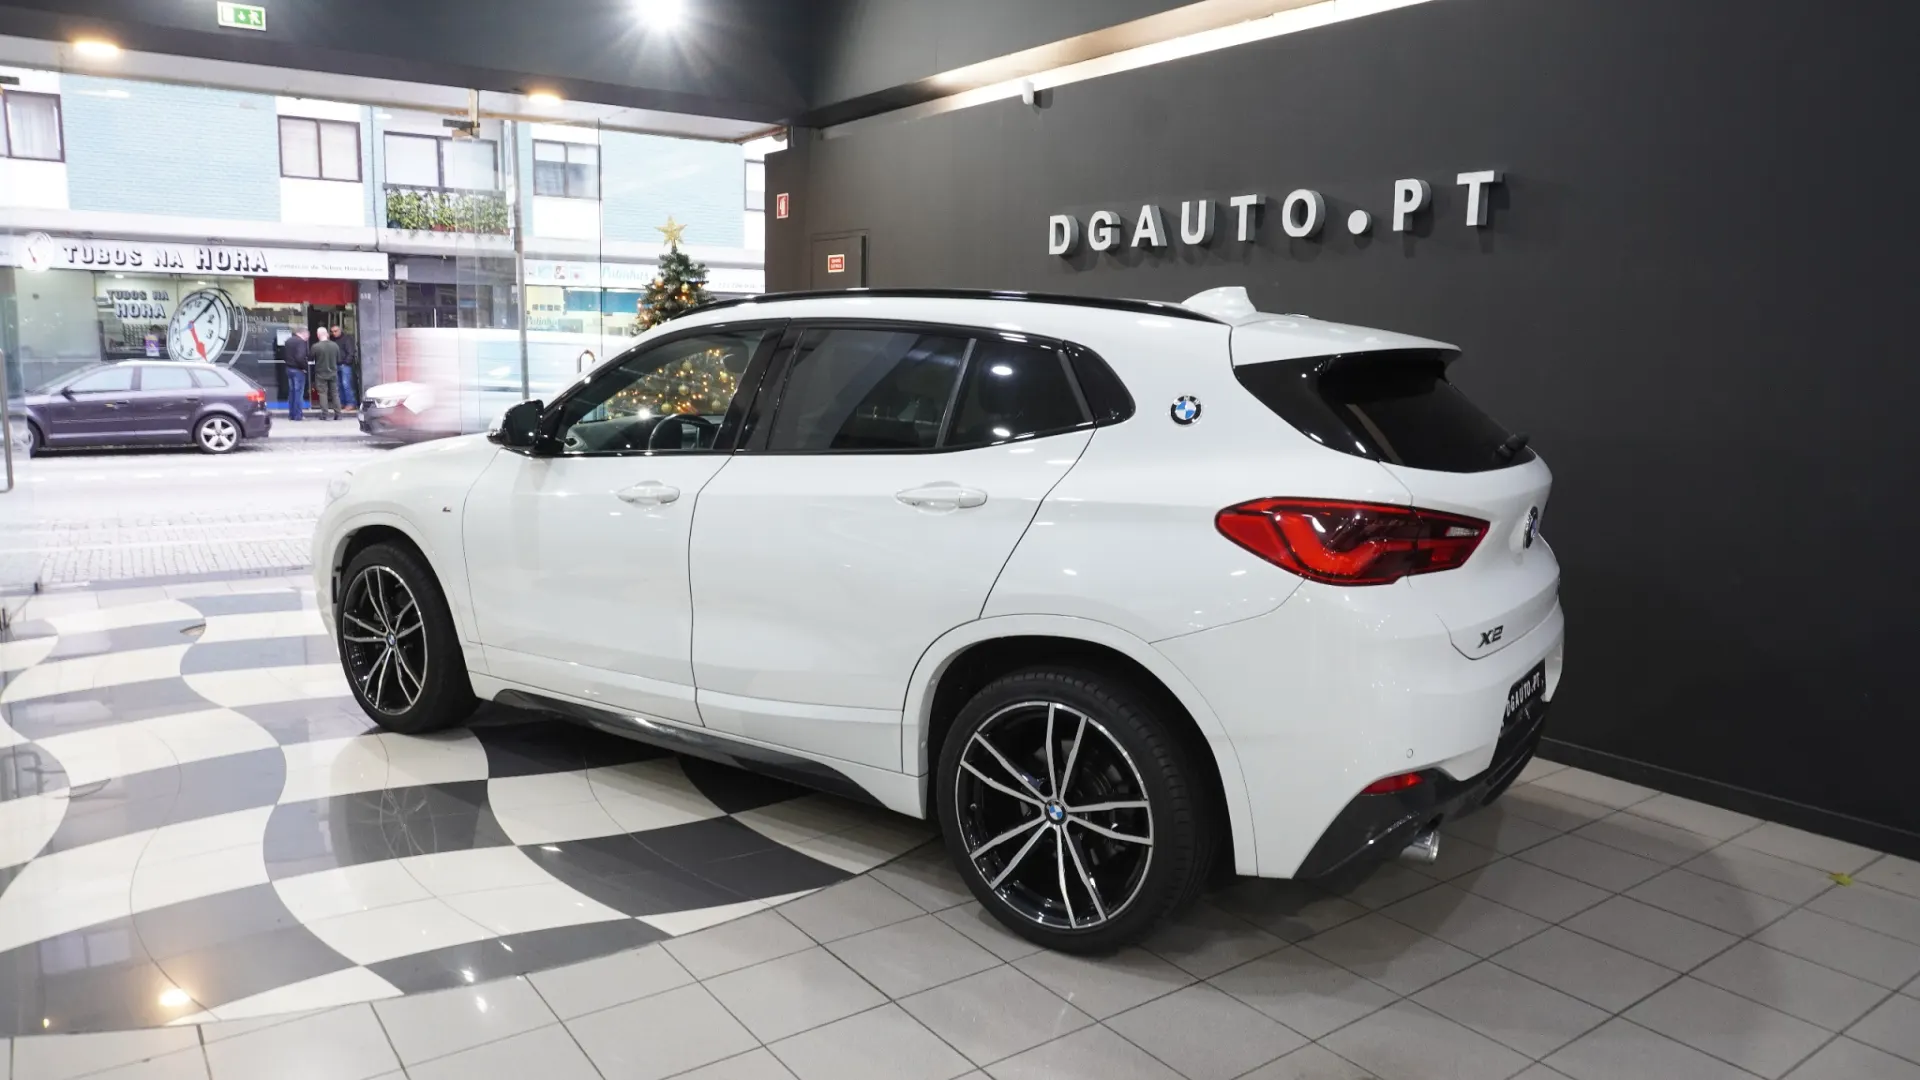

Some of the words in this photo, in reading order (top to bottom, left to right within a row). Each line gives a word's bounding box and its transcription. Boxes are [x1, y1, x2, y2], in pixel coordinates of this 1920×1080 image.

[1048, 170, 1502, 256] DGAUTO.PT
[63, 244, 143, 267] TUBOS
[154, 248, 184, 269] NA
[195, 247, 269, 272] HORA
[106, 289, 147, 301] TUBOS
[152, 290, 170, 301] NA
[116, 303, 166, 319] HORA
[1477, 625, 1504, 649] X2
[1506, 671, 1540, 717] DGAUTO.PT
